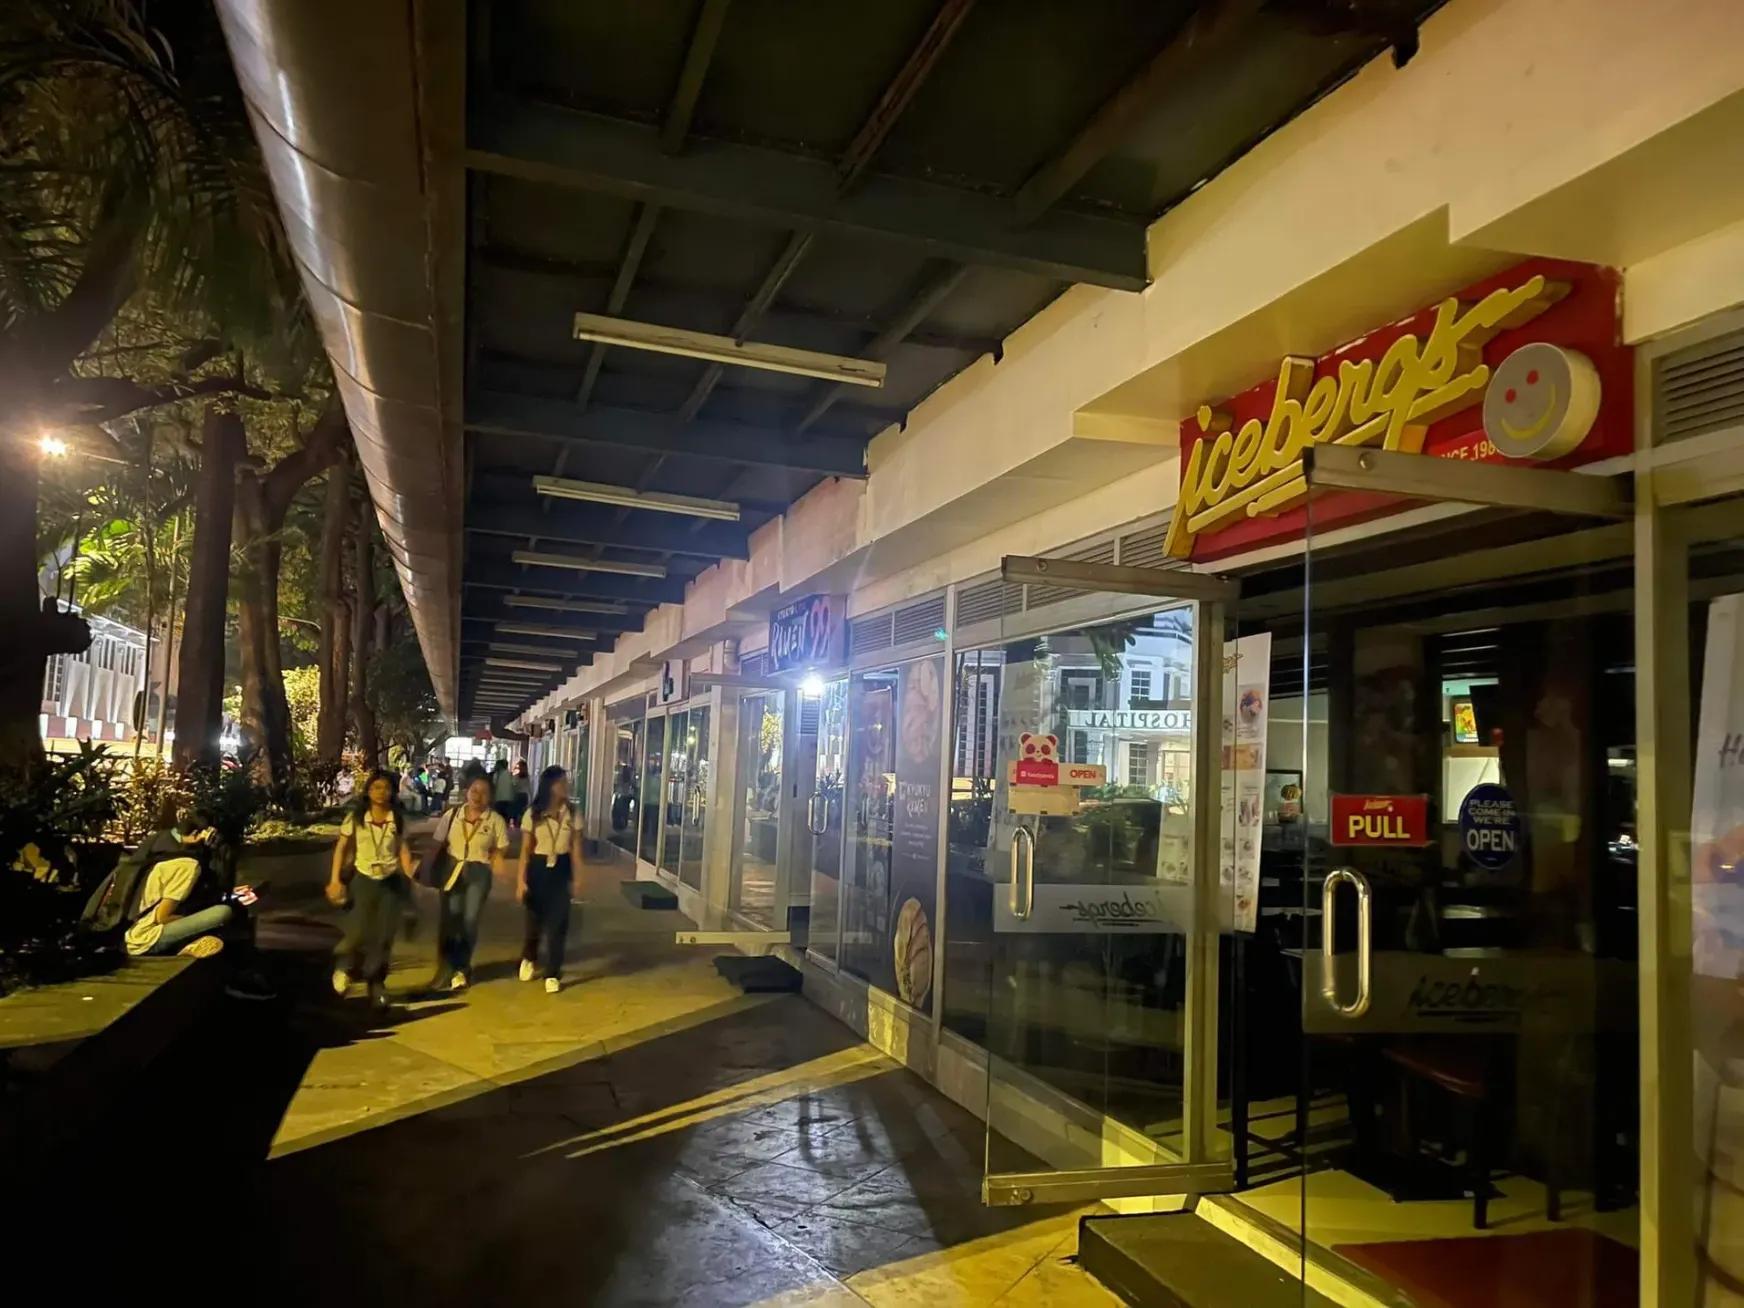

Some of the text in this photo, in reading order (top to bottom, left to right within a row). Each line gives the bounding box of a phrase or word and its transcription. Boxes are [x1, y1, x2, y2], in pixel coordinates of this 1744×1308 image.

[1070, 769, 1097, 779] OPEN
[1469, 799, 1513, 808] PLEASE
[1349, 815, 1411, 839] PULL
[1466, 829, 1515, 851] OPEN
